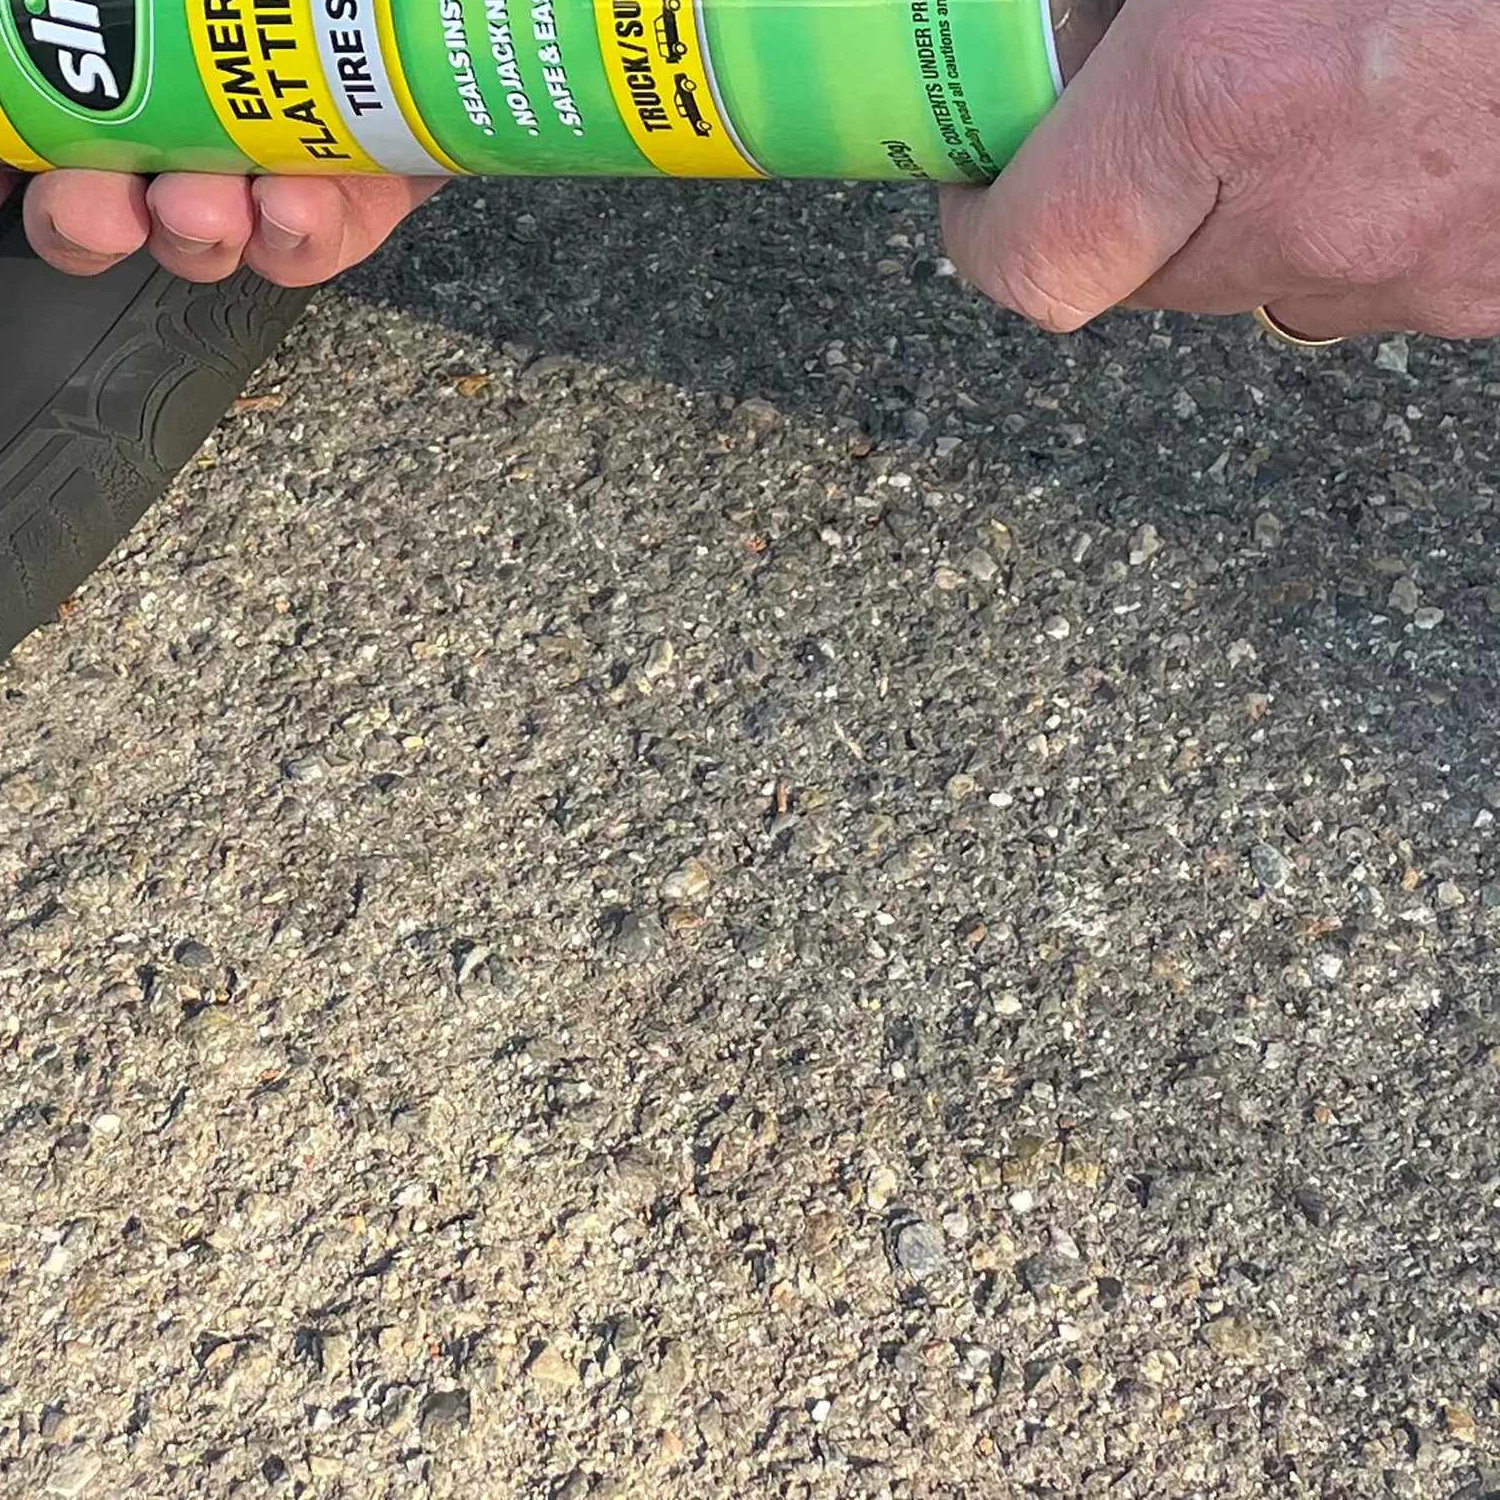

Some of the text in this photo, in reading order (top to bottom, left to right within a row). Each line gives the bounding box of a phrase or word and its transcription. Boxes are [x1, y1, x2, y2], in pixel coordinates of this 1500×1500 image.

[327, 28, 383, 116] TIRE
[489, 21, 523, 92] JACK
[538, 43, 562, 64] &
[914, 27, 939, 80] UNDER
[939, 19, 960, 78] cautions
[273, 69, 352, 159] FLAT
[445, 47, 496, 125] SEALS
[507, 92, 539, 127] NO
[542, 64, 583, 124] SAFE
[926, 82, 961, 146] CONTENTS
[948, 81, 963, 96] all
[953, 99, 971, 125] read
